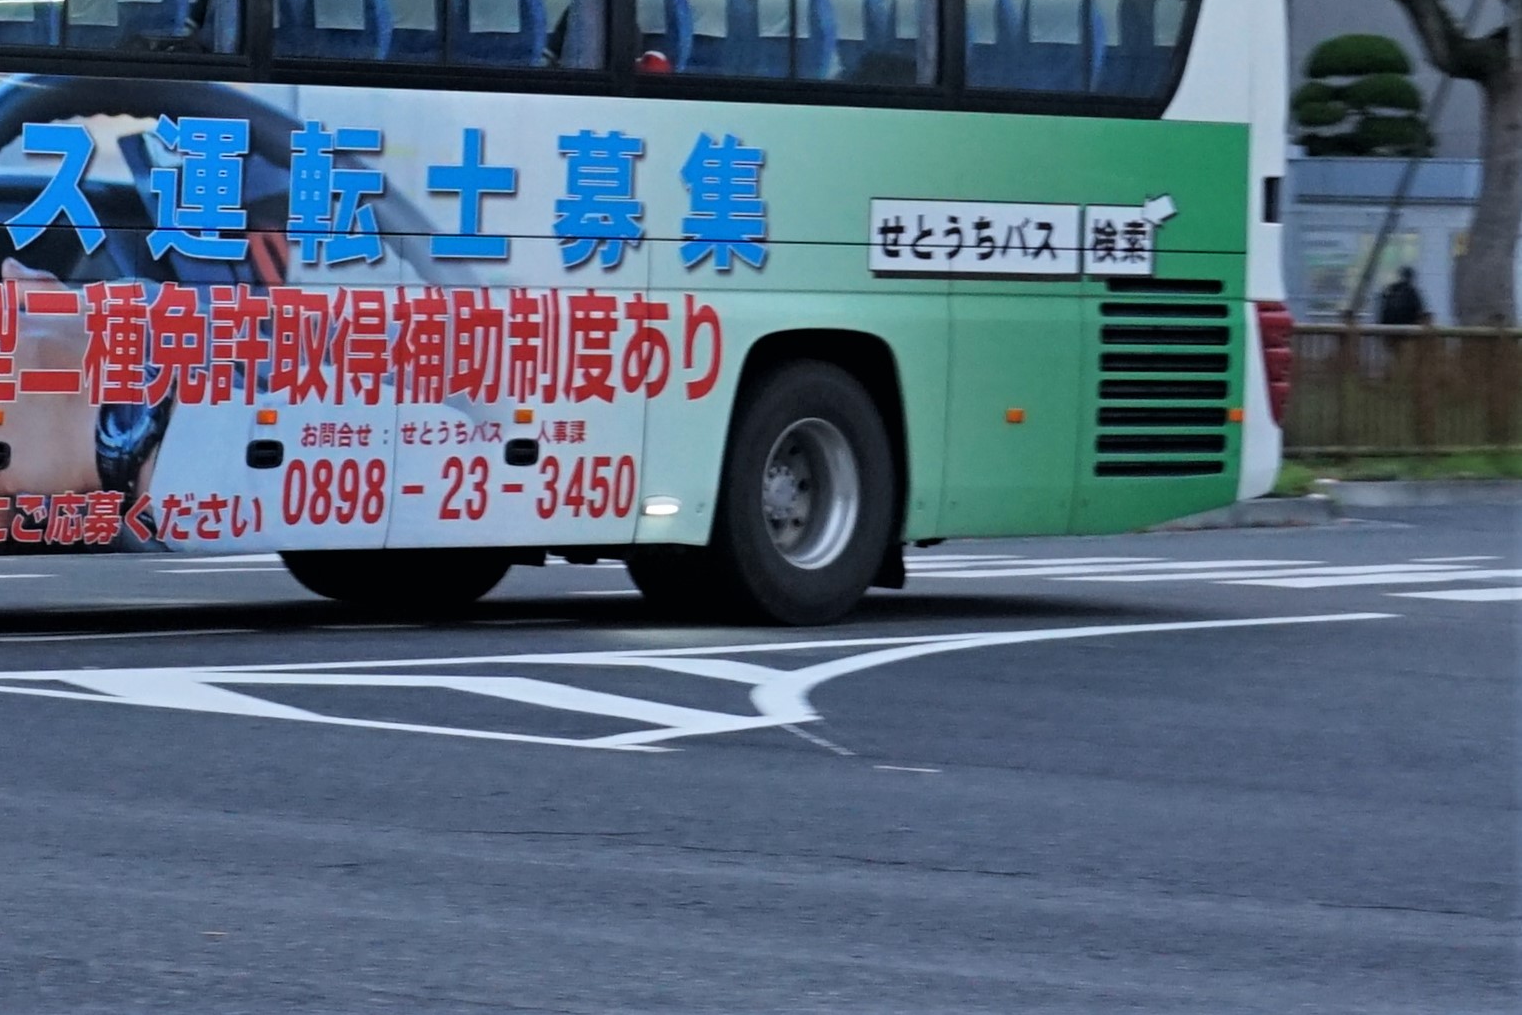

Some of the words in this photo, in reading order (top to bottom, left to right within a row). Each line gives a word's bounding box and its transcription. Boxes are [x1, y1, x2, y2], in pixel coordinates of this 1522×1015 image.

[879, 214, 1058, 261] せとうちバス
[1093, 219, 1149, 264] 検索
